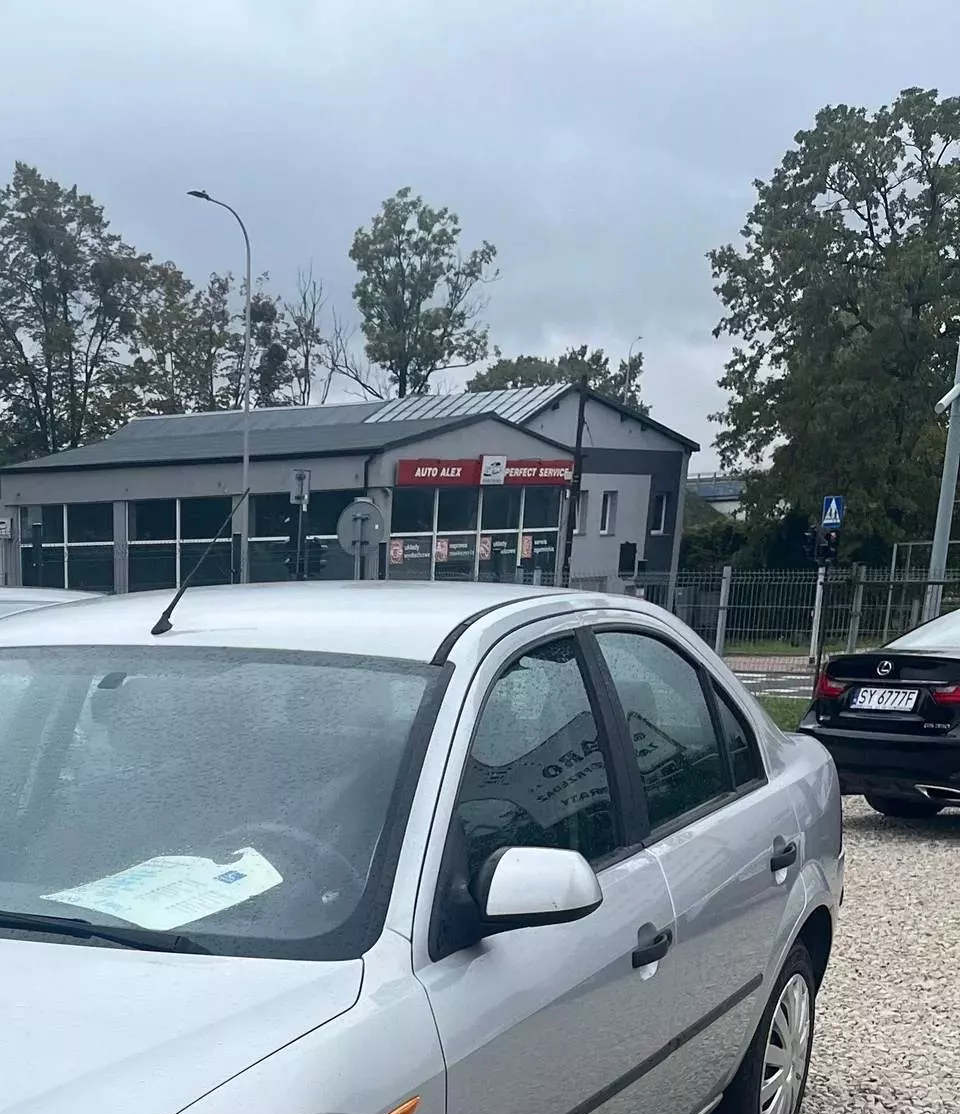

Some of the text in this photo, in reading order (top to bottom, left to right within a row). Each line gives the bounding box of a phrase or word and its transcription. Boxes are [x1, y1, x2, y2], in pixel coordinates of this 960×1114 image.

[414, 467, 463, 478] AUTO ALEX
[505, 467, 538, 478] PERFECT
[859, 689, 916, 706] SY 6777F
